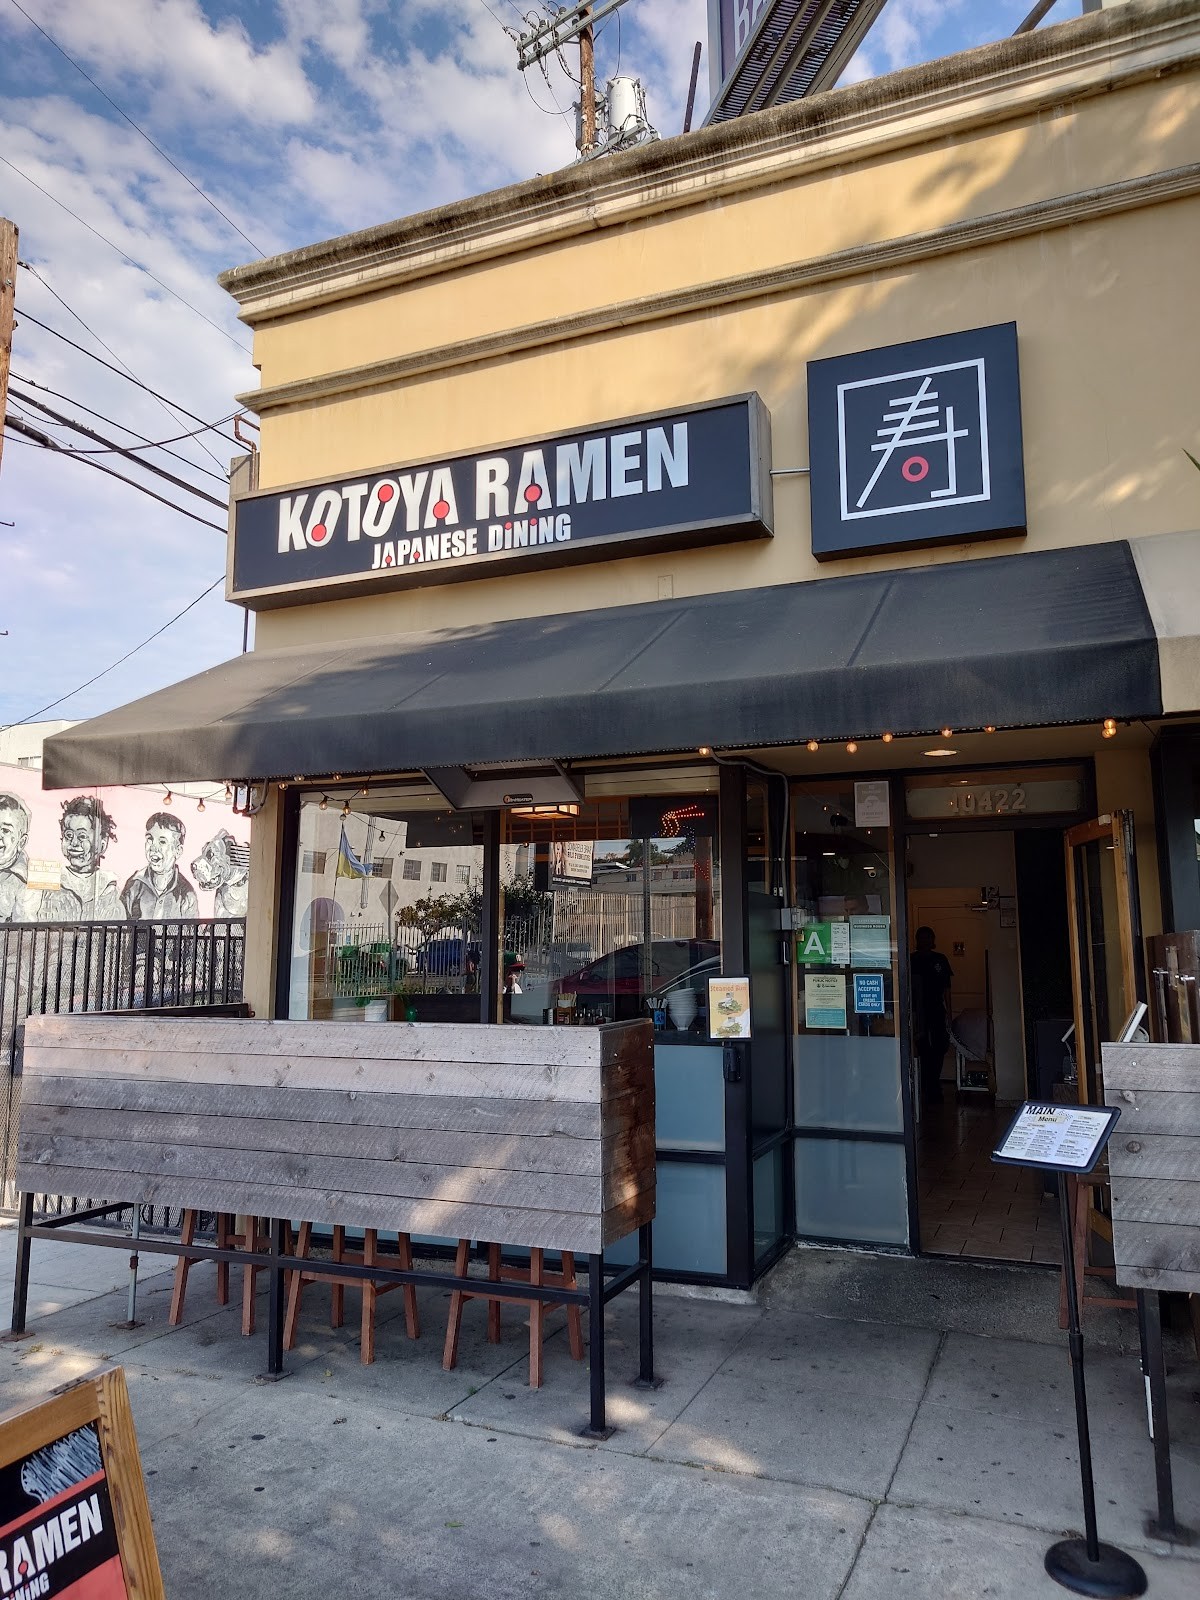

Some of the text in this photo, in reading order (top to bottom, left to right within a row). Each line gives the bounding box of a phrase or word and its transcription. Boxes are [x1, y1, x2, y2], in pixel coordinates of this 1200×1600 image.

[278, 421, 689, 554] KOTOYA RAMEN
[371, 528, 478, 570] JAPANESE
[952, 788, 1026, 813] 10422
[803, 931, 826, 955] A
[710, 984, 734, 992] Steamed
[1025, 1106, 1056, 1115] MAIN
